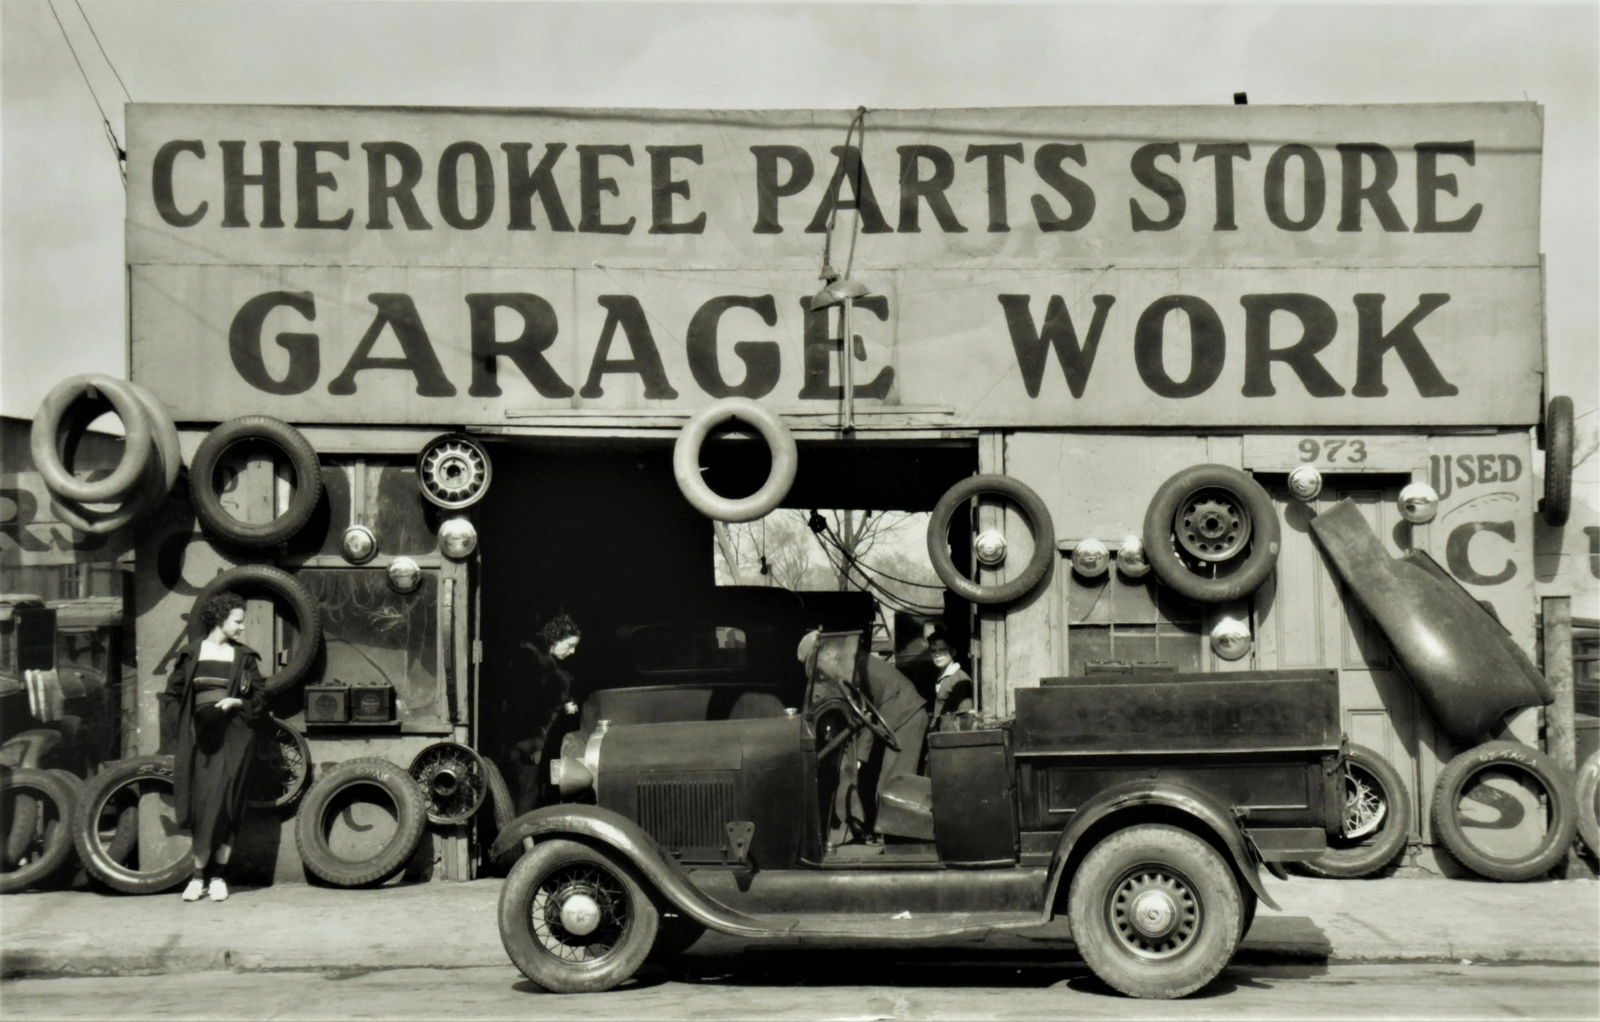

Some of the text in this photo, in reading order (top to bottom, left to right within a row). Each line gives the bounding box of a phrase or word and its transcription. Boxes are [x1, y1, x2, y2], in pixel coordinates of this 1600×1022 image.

[153, 140, 1482, 234] CHEROKEE PARTS STORE
[230, 291, 1460, 399] GARAGE WORK
[1298, 438, 1368, 463] 973
[1430, 453, 1522, 500] USED
